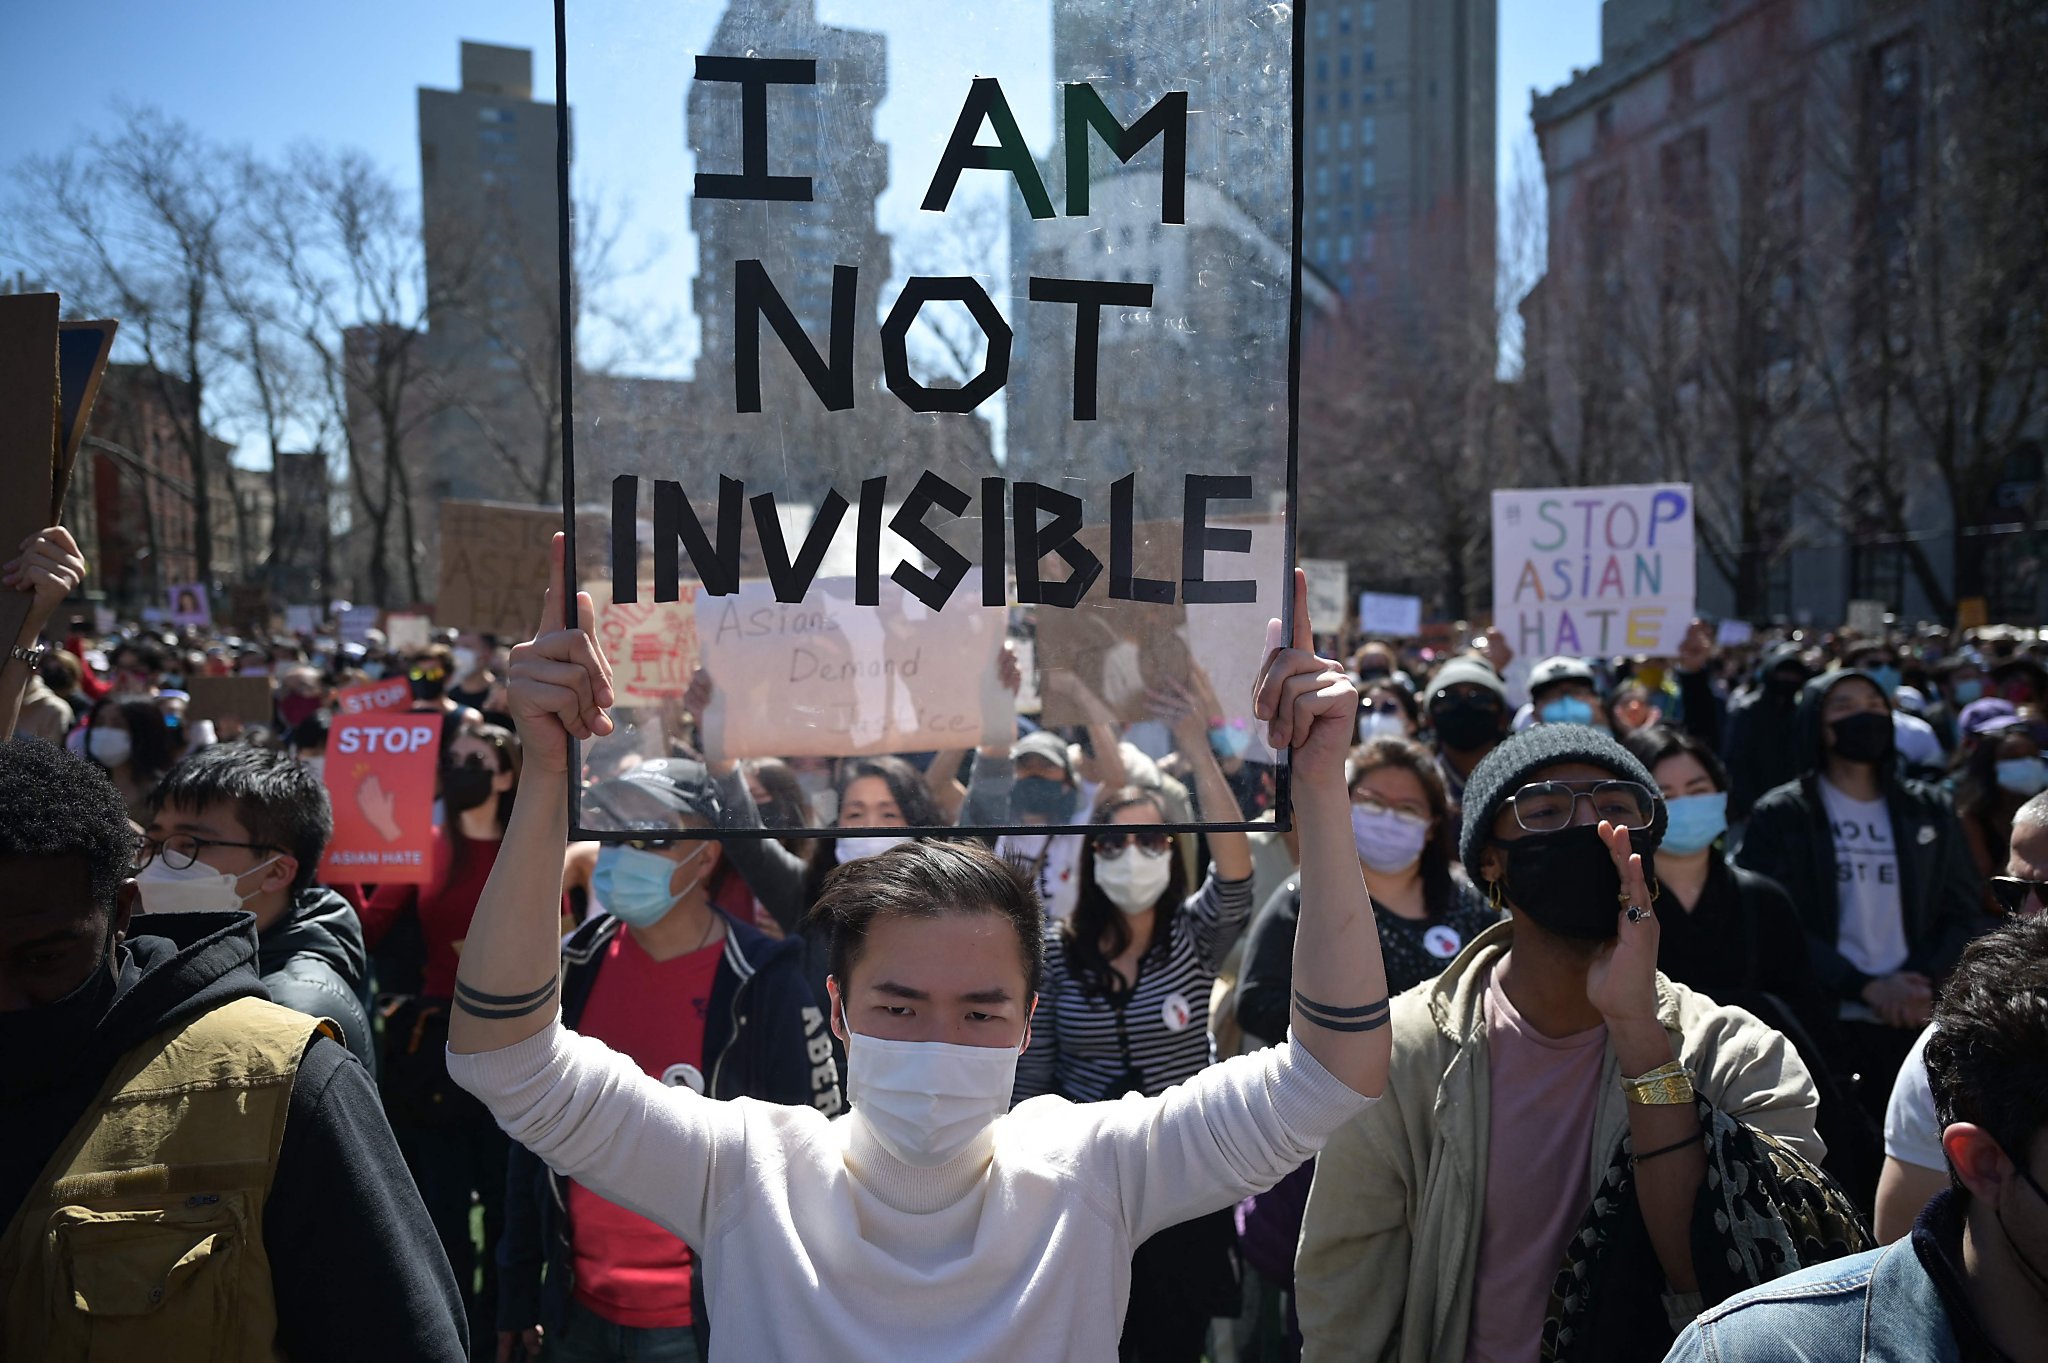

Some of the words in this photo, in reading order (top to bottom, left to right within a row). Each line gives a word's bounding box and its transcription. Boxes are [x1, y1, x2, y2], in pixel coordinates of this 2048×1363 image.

[694, 55, 816, 202] I
[920, 74, 1188, 225] AM
[735, 258, 1154, 421] NOT
[611, 469, 1257, 613] INVISIBLE
[444, 547, 550, 590] ASIA
[469, 588, 549, 630] HAT
[714, 599, 842, 646] Asians
[1518, 607, 1668, 656] HATE
[788, 646, 922, 683] Demand
[345, 683, 407, 714] STOP
[338, 726, 433, 754] STOP
[329, 851, 379, 866] ASIAN
[381, 851, 423, 866] HATE
